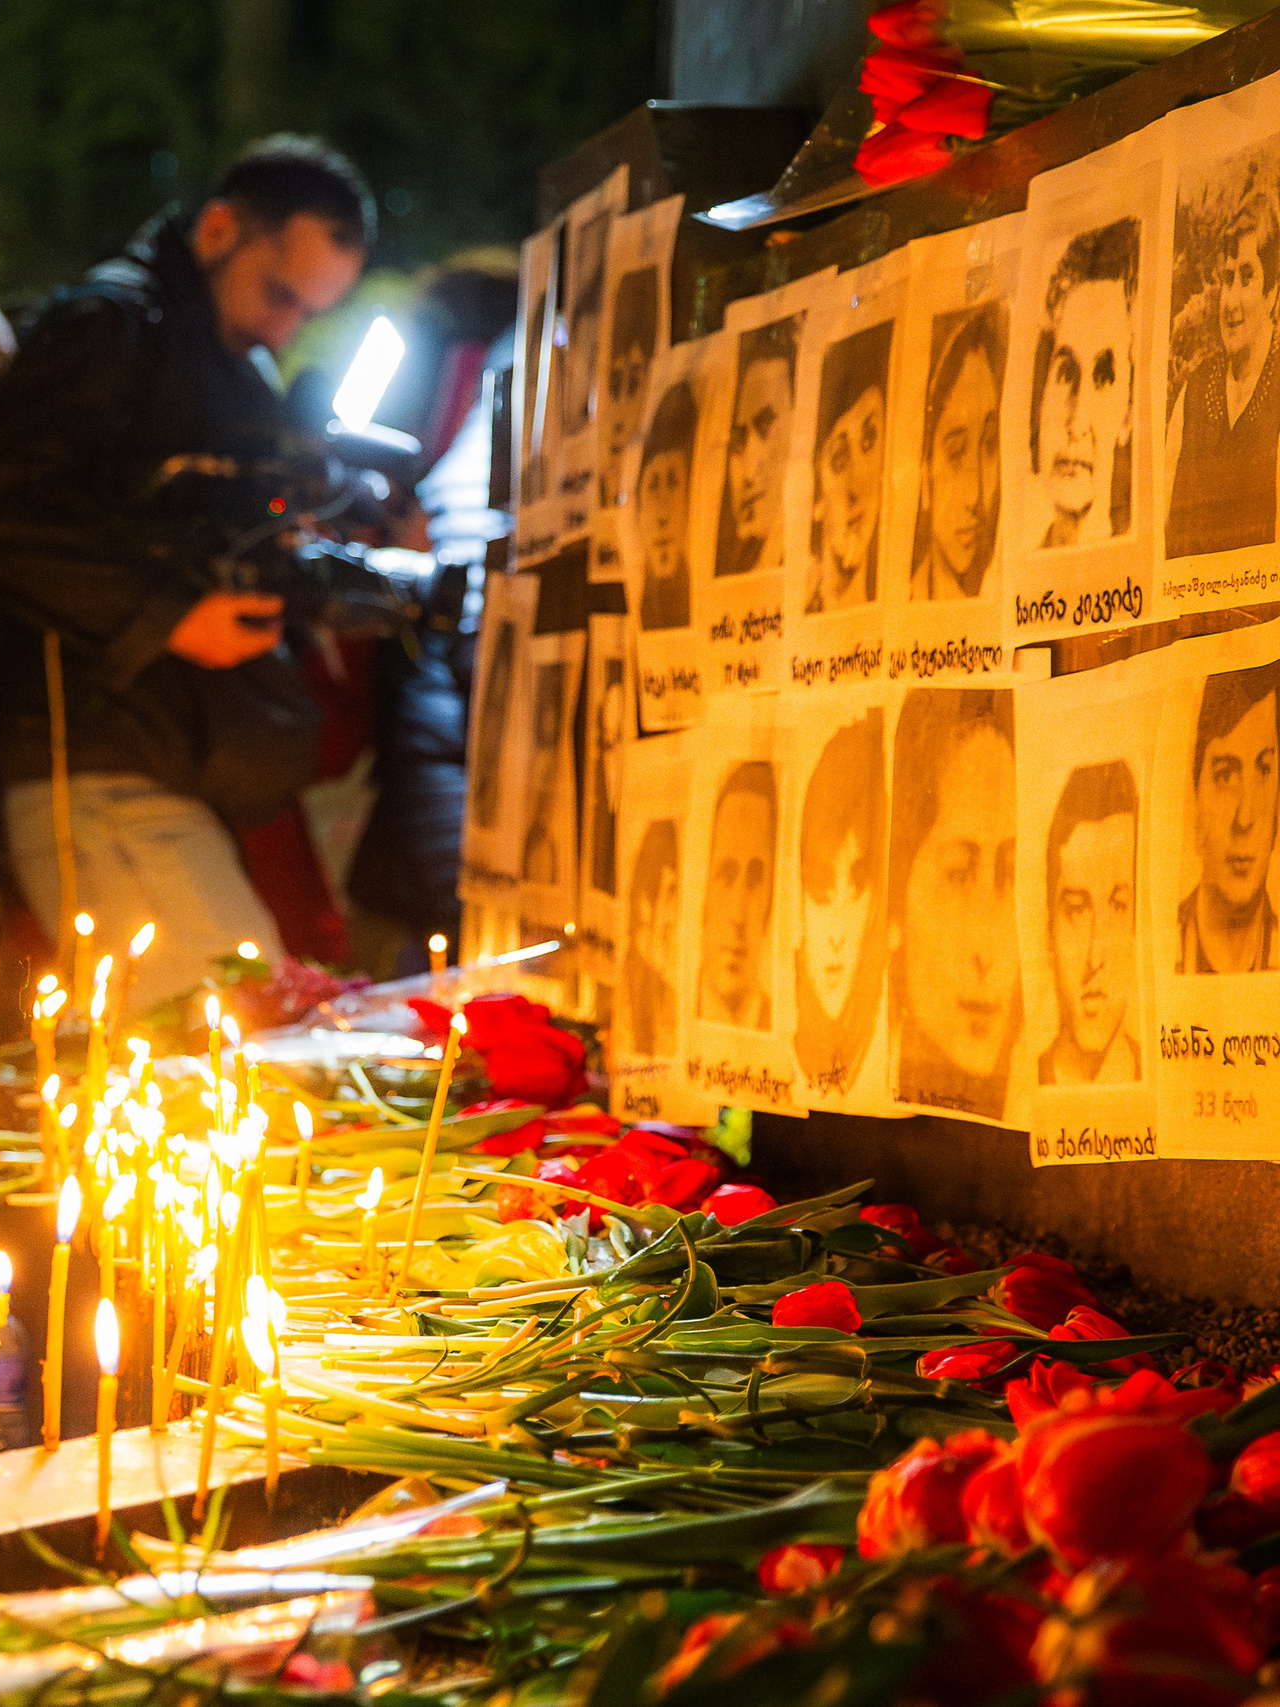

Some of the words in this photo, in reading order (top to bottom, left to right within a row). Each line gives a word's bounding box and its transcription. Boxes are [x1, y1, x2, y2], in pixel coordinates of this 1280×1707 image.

[1073, 576, 1144, 626] კიკვიძე
[1194, 1091, 1216, 1118] 33
[1223, 1091, 1258, 1124] წლის
[1056, 1127, 1157, 1160] ქარსელაძ
